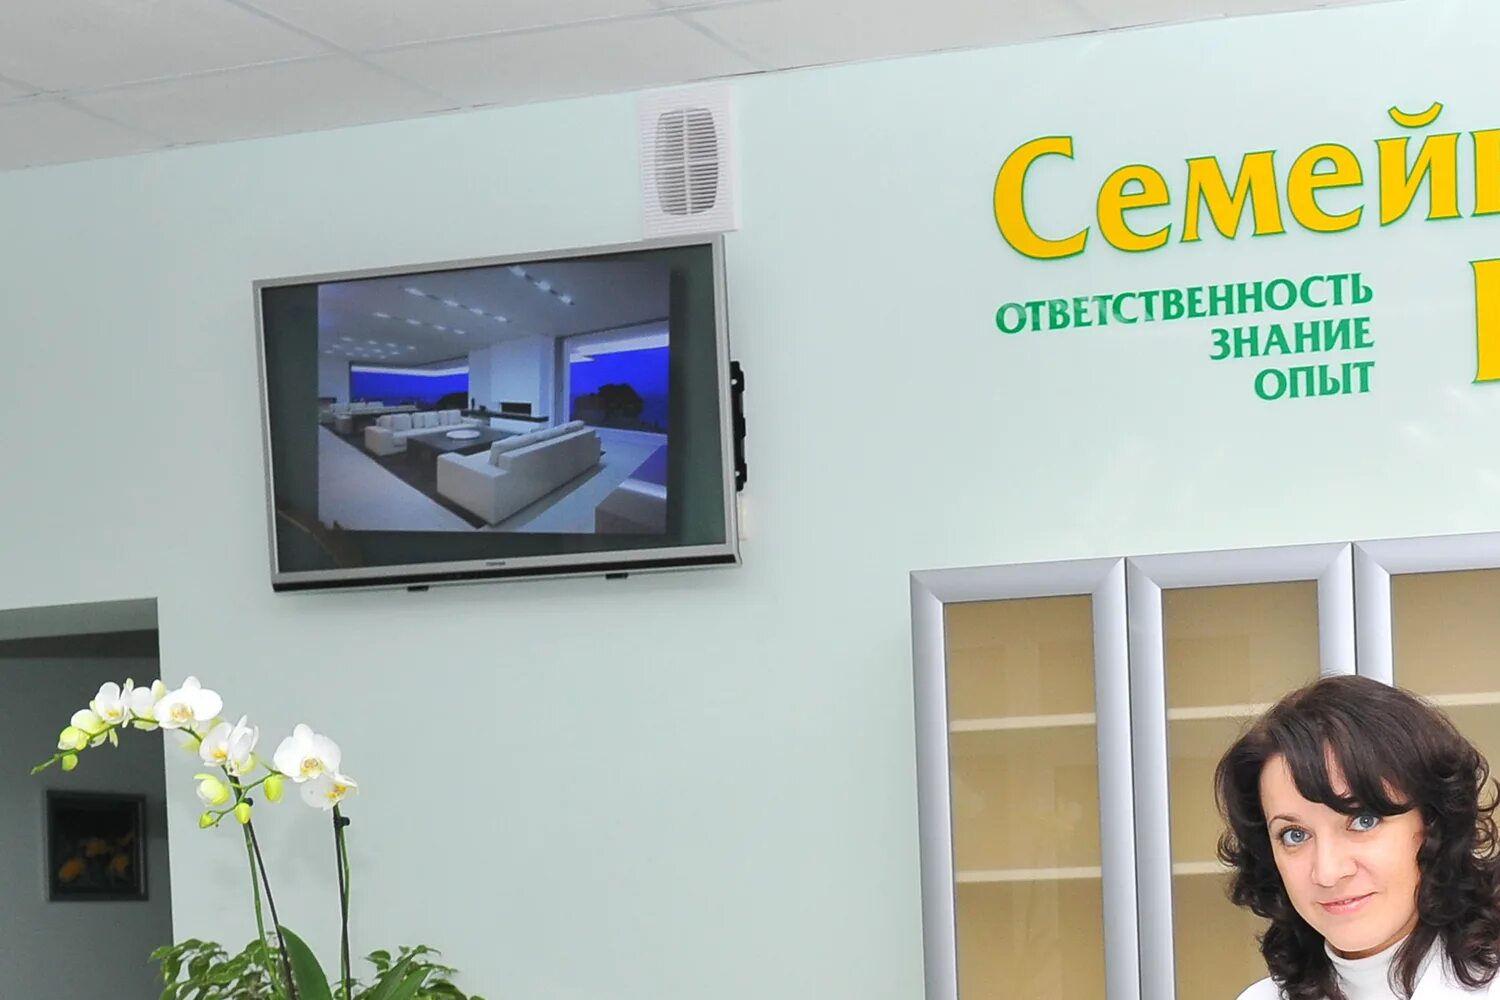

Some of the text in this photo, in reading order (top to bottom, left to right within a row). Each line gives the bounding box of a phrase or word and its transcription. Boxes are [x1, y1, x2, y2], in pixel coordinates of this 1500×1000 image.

[995, 272, 1374, 335] ОТВЕТСТВЕННОСТЬ
[1209, 316, 1376, 361] ЗНАНИЕ
[1254, 360, 1376, 401] ОПЫТ
